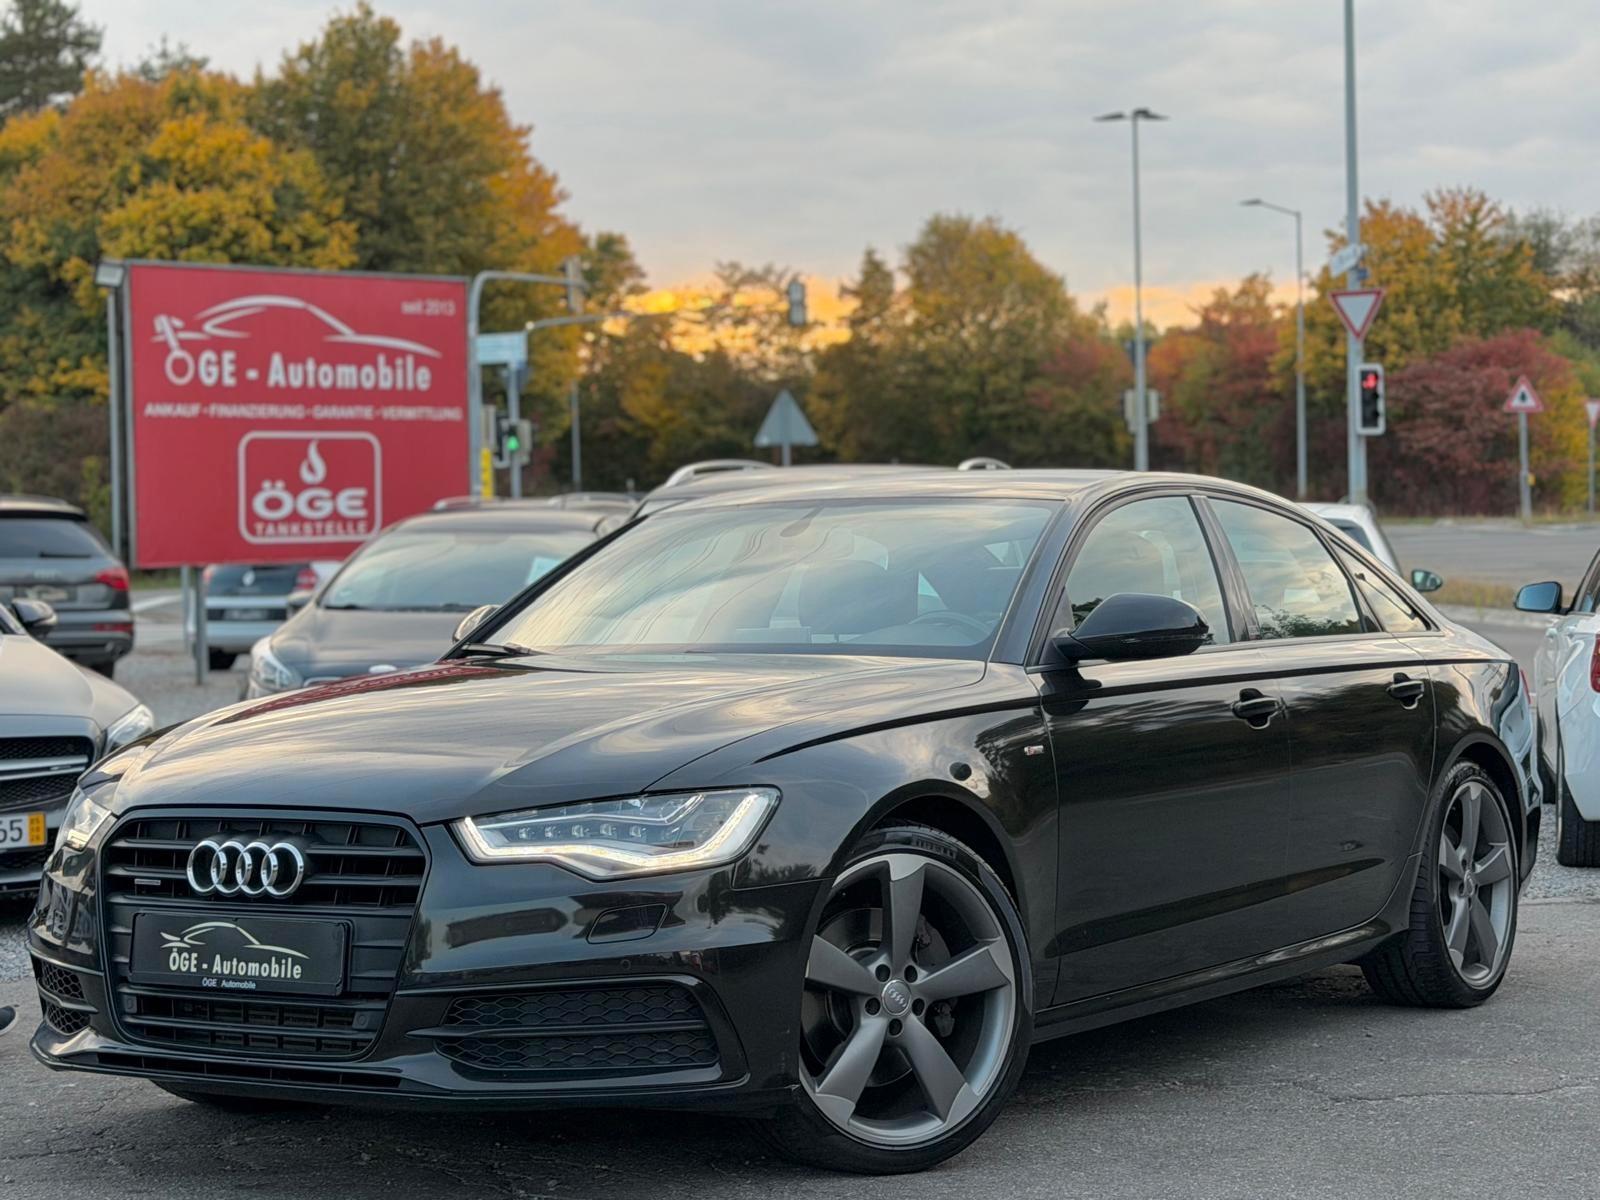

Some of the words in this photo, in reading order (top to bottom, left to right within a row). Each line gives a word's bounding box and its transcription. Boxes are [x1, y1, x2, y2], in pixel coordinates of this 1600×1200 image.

[267, 352, 432, 391] Automobile
[145, 402, 200, 418] ANKAUF
[313, 404, 374, 420] GARANTIE
[252, 479, 369, 520] ÖGE
[254, 521, 368, 537] TANKSTELLE
[212, 953, 302, 979] Automobile
[221, 979, 256, 990] Automobile
